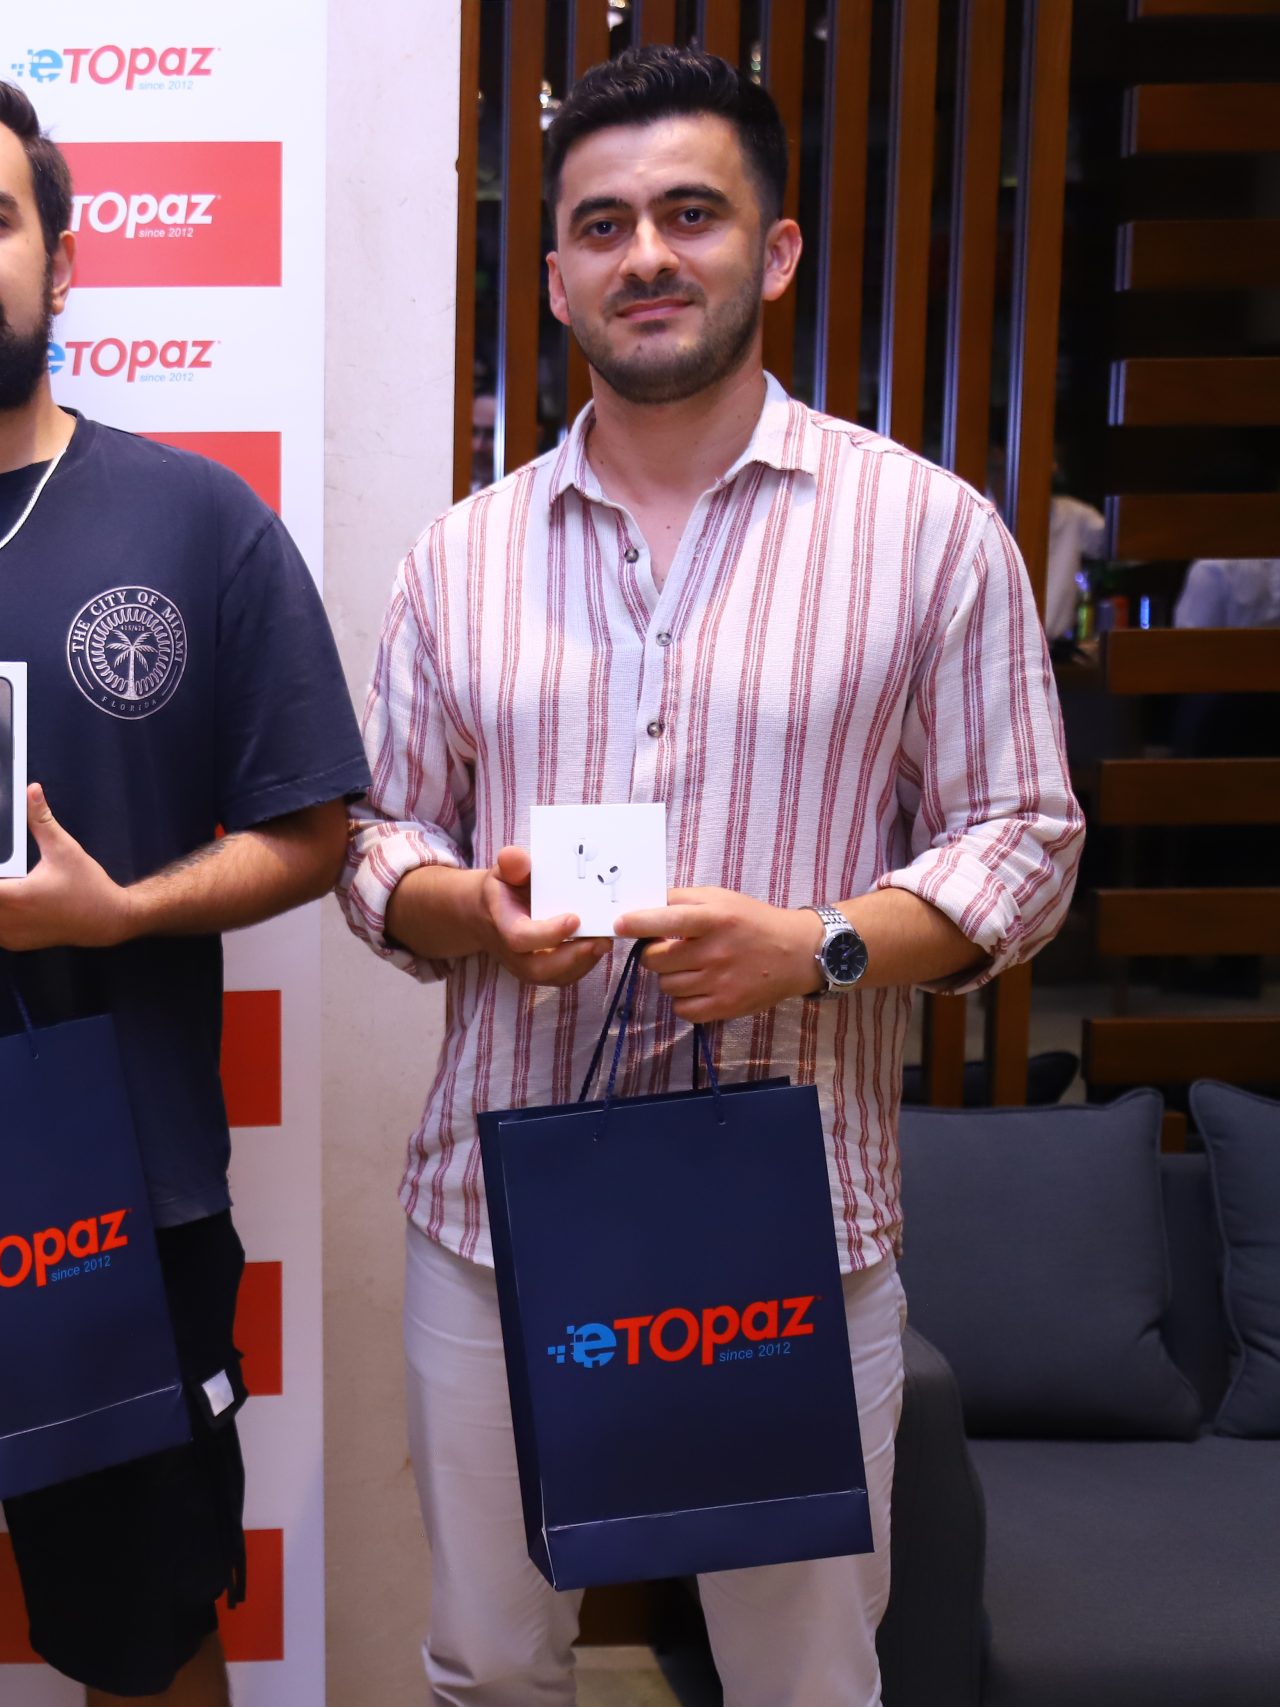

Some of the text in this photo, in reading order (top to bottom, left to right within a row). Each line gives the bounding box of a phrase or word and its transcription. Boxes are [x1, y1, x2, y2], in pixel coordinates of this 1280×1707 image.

[25, 44, 215, 90] eTOpaz
[139, 80, 194, 90] since 2012
[139, 228, 194, 238] since 2012
[140, 372, 194, 382] since 2012
[72, 591, 183, 662] THE CITY OF MIAMI
[102, 696, 157, 711] FLORIDA
[51, 1256, 111, 1282] since 2012
[567, 1296, 817, 1369] eTOpaz
[719, 1341, 791, 1362] since 2012
